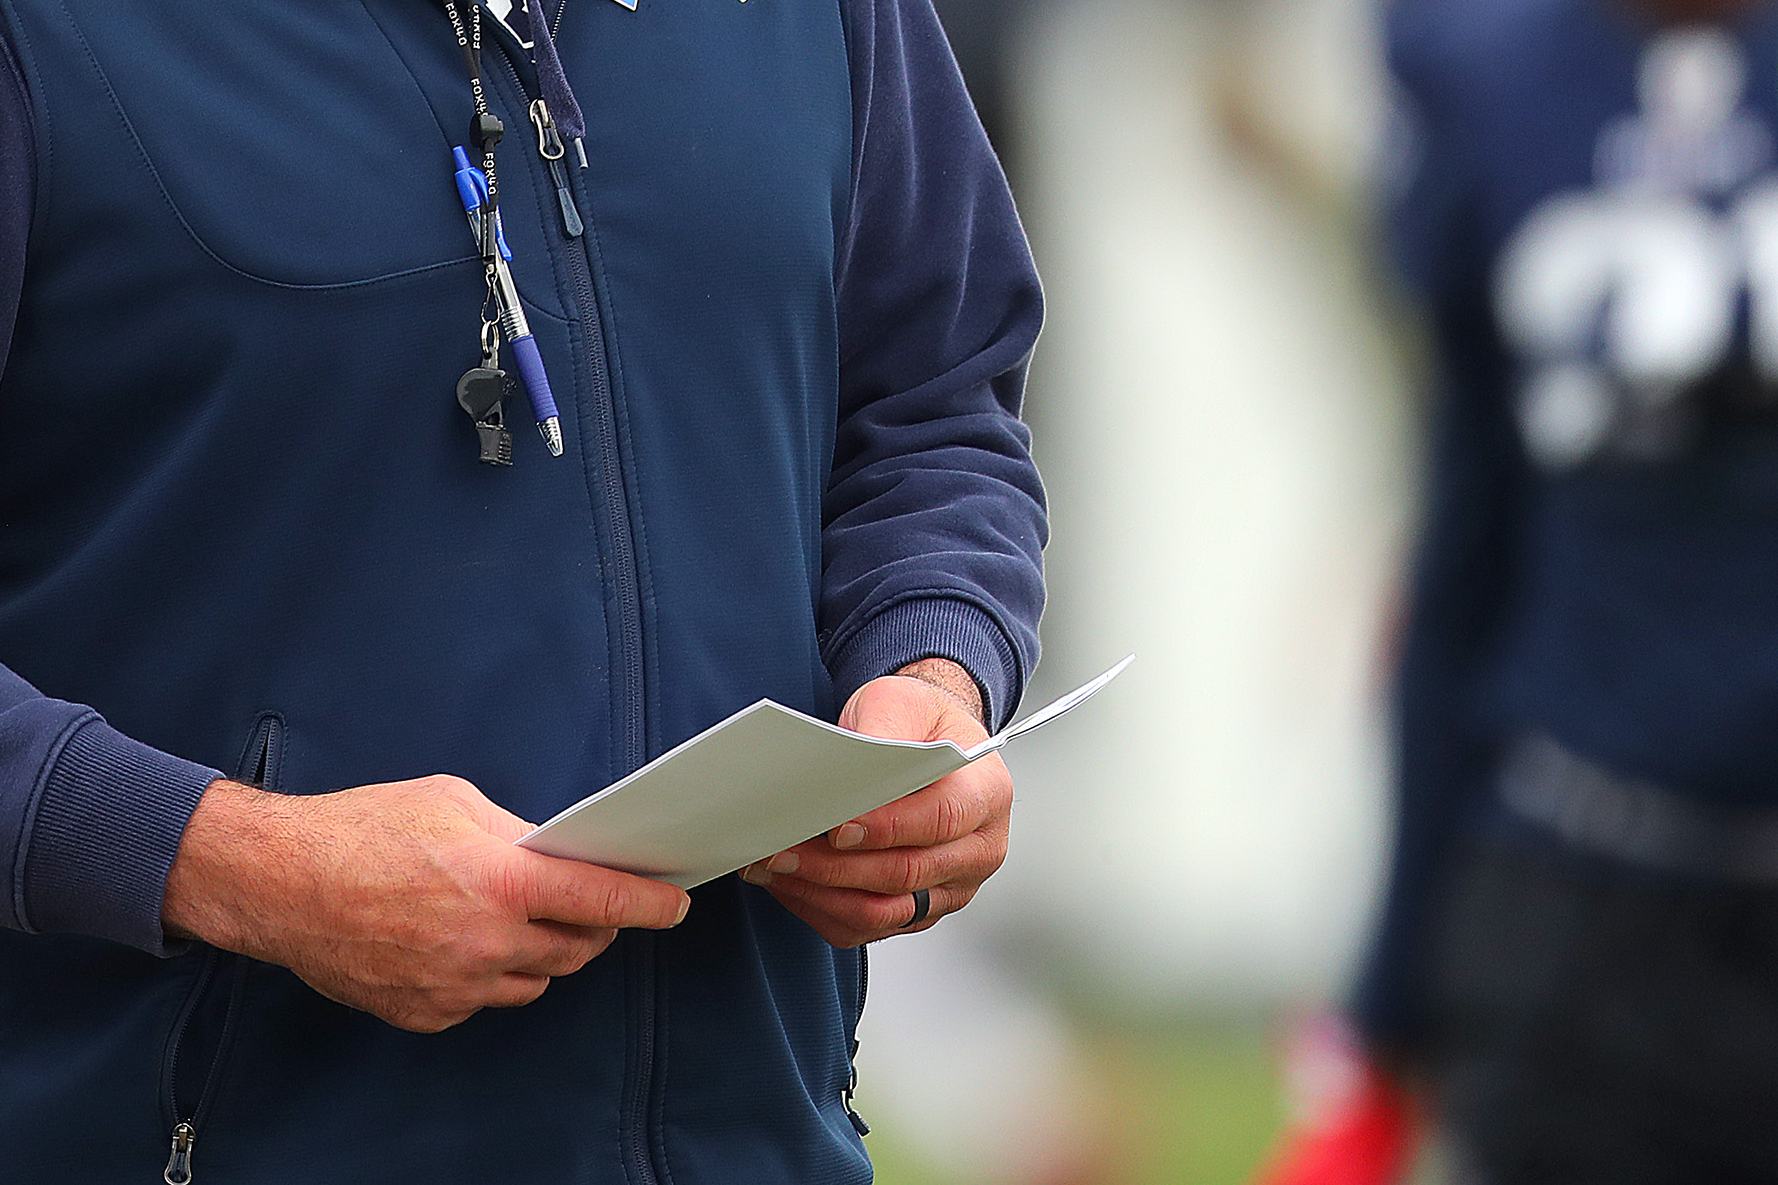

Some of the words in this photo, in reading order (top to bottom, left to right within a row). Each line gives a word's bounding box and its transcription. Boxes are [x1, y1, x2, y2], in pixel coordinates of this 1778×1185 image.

[445, 2, 468, 46] FOX40
[471, 77, 489, 116] FOX4
[483, 152, 497, 195] FOX40
